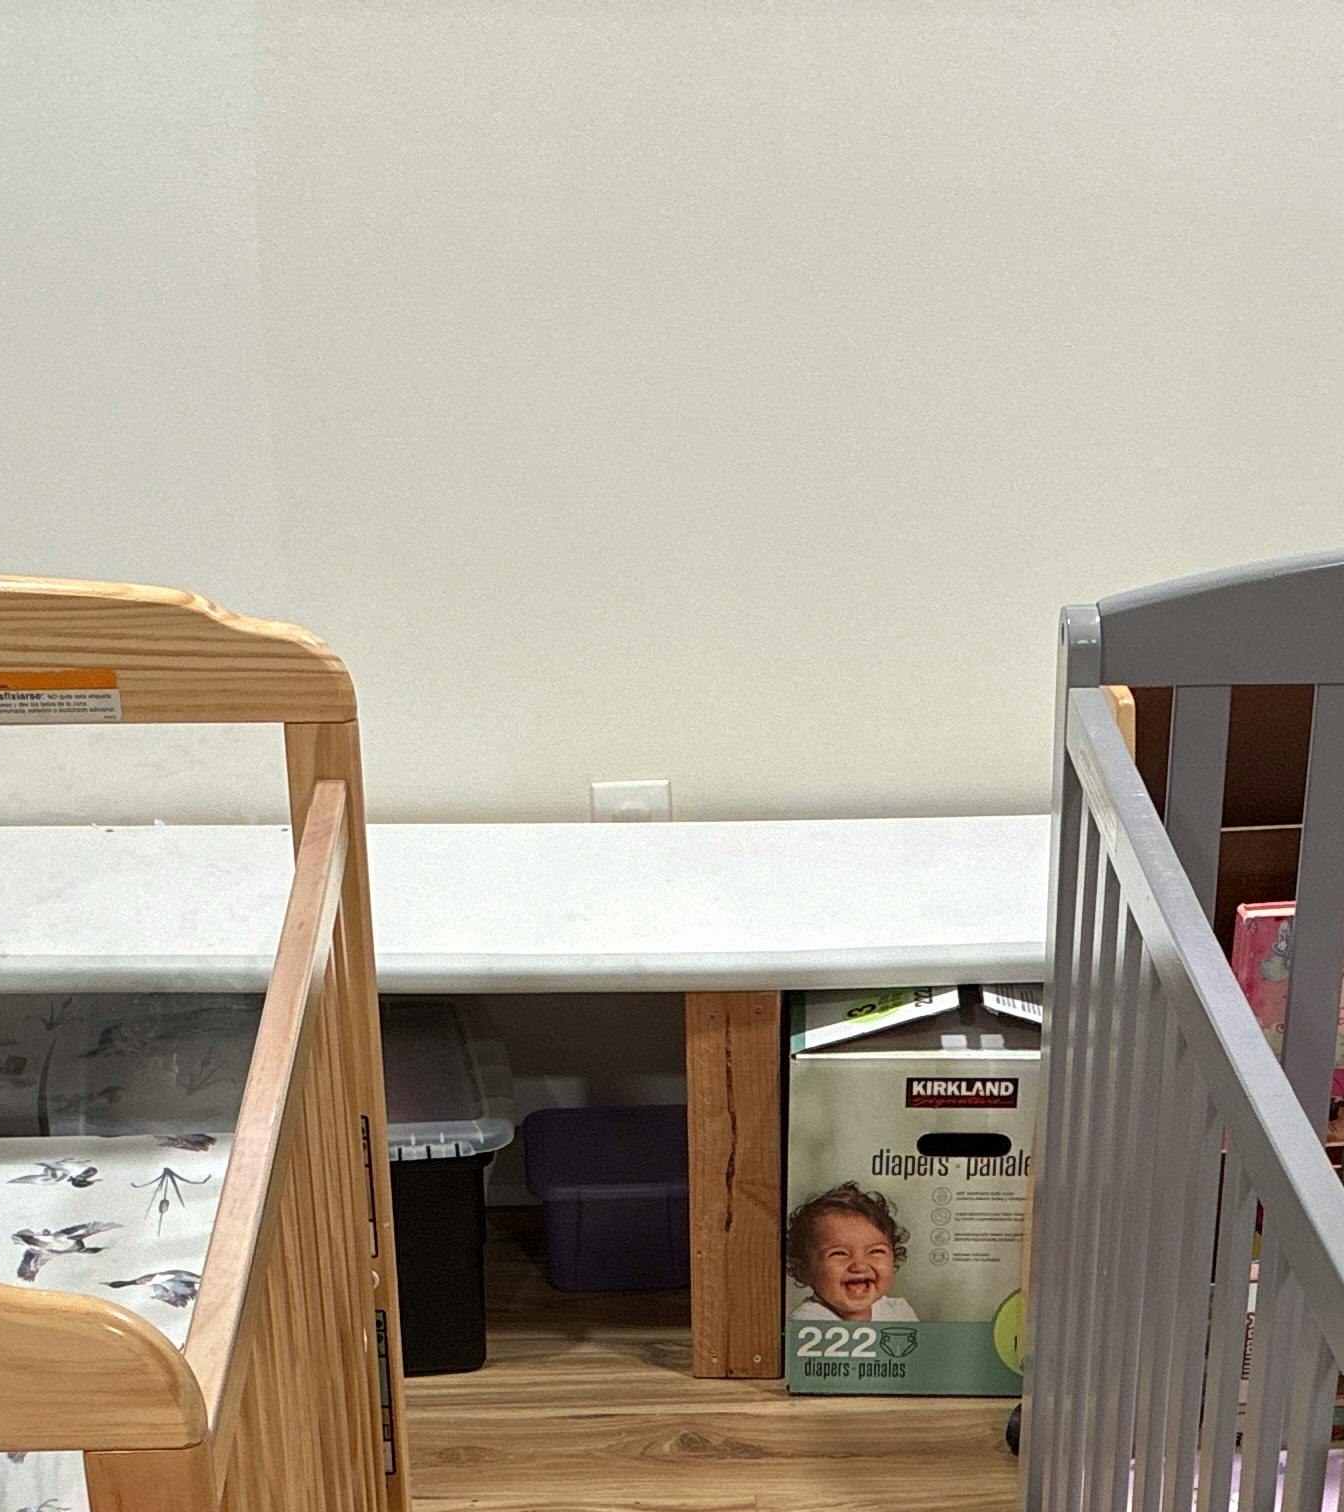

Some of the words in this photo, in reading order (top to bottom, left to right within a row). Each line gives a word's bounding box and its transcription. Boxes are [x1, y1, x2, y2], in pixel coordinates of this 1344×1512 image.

[912, 1080, 1015, 1096] KIRKLAND
[796, 1326, 878, 1358] 222
[804, 1358, 850, 1379] diapers
[858, 1358, 906, 1380] pañales
